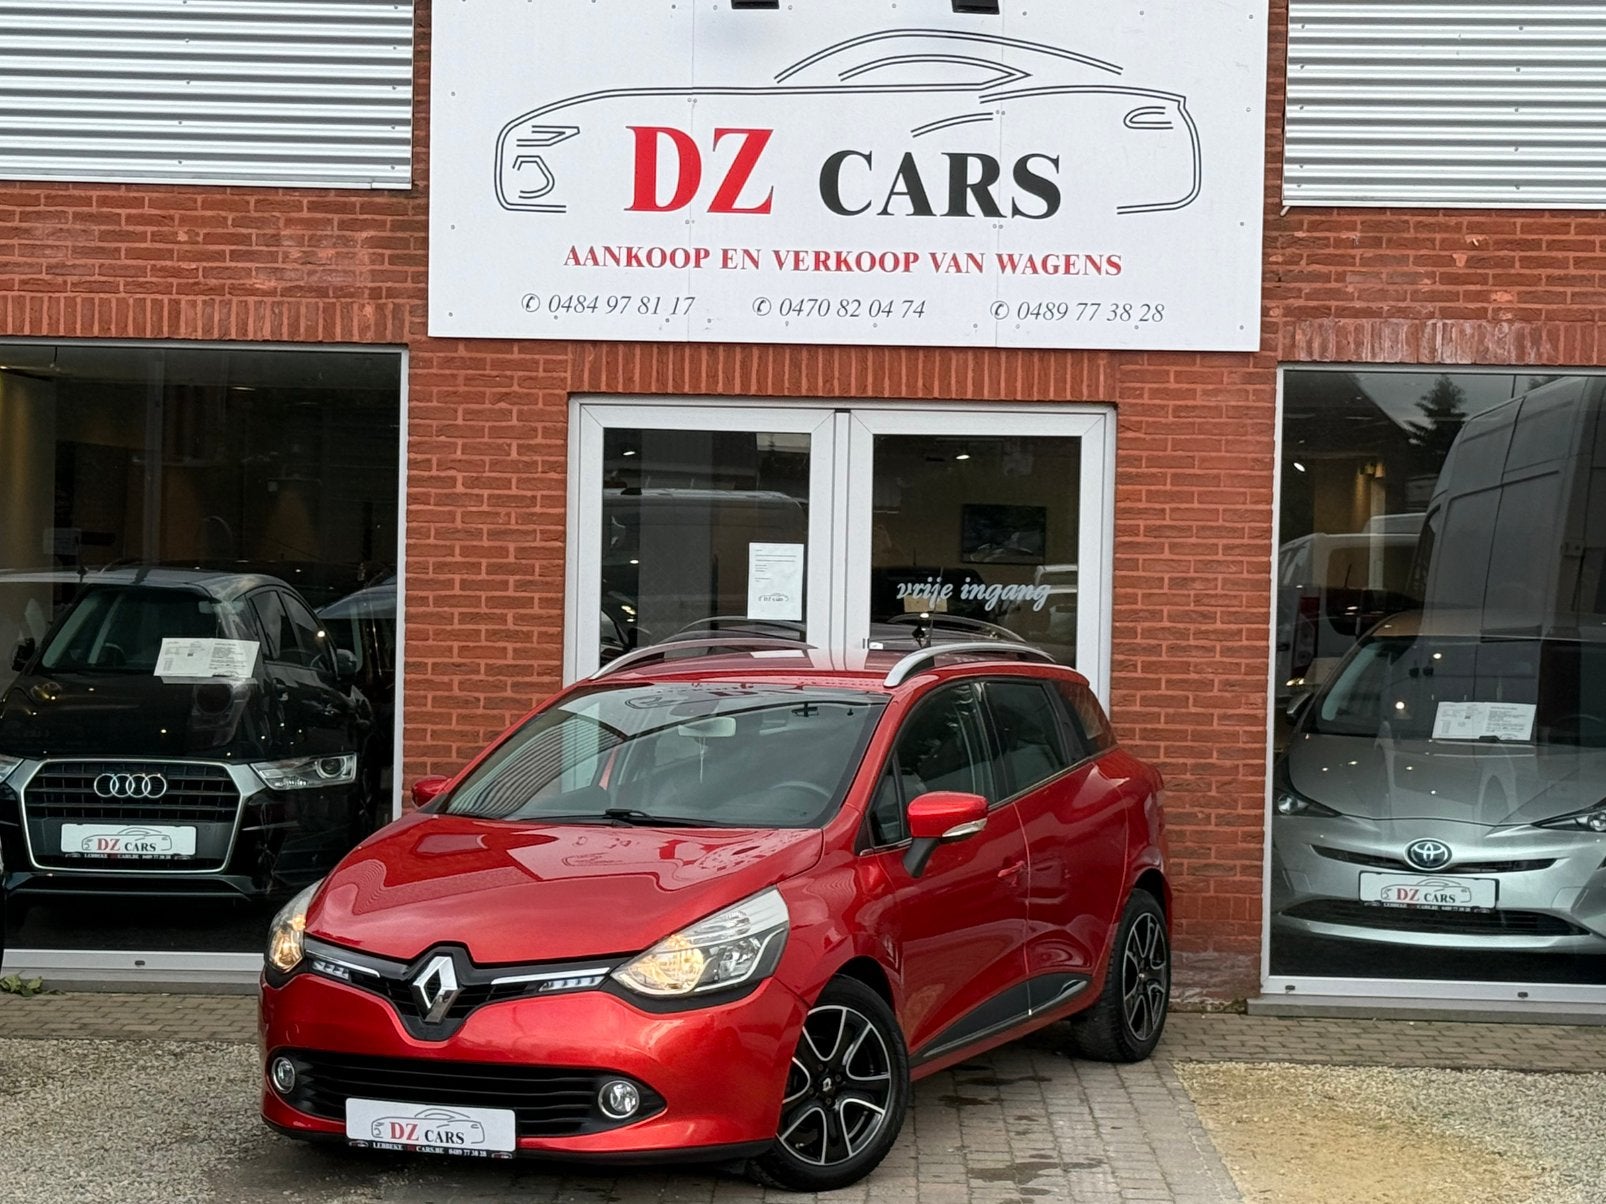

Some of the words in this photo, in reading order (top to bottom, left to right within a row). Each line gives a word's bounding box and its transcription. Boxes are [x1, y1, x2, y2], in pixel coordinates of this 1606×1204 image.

[624, 126, 774, 214] DZ
[819, 150, 1061, 218] CARS
[563, 245, 710, 269] AANKOOP
[719, 248, 761, 269] EN
[772, 250, 919, 273] VERKOOP
[928, 252, 985, 273] VAN
[995, 253, 1122, 276] WAGENS
[548, 295, 598, 313] 0484
[605, 295, 631, 314] 97
[637, 296, 660, 315] 81
[670, 297, 696, 316] 17
[779, 298, 831, 317] 0470
[837, 299, 861, 318] 82
[869, 300, 893, 318] 04
[902, 300, 926, 318] 74
[1017, 302, 1069, 321] 0489
[1076, 303, 1101, 321] 77
[1107, 303, 1132, 322] 38
[1139, 303, 1165, 322] 28
[897, 577, 954, 609] vrije
[960, 577, 1051, 612] ingang
[96, 838, 120, 851] DZ
[124, 842, 157, 852] CARS
[1396, 888, 1420, 901] DZ
[1423, 893, 1456, 904] CARS
[390, 1122, 419, 1142] DZ
[424, 1129, 465, 1145] CARS
